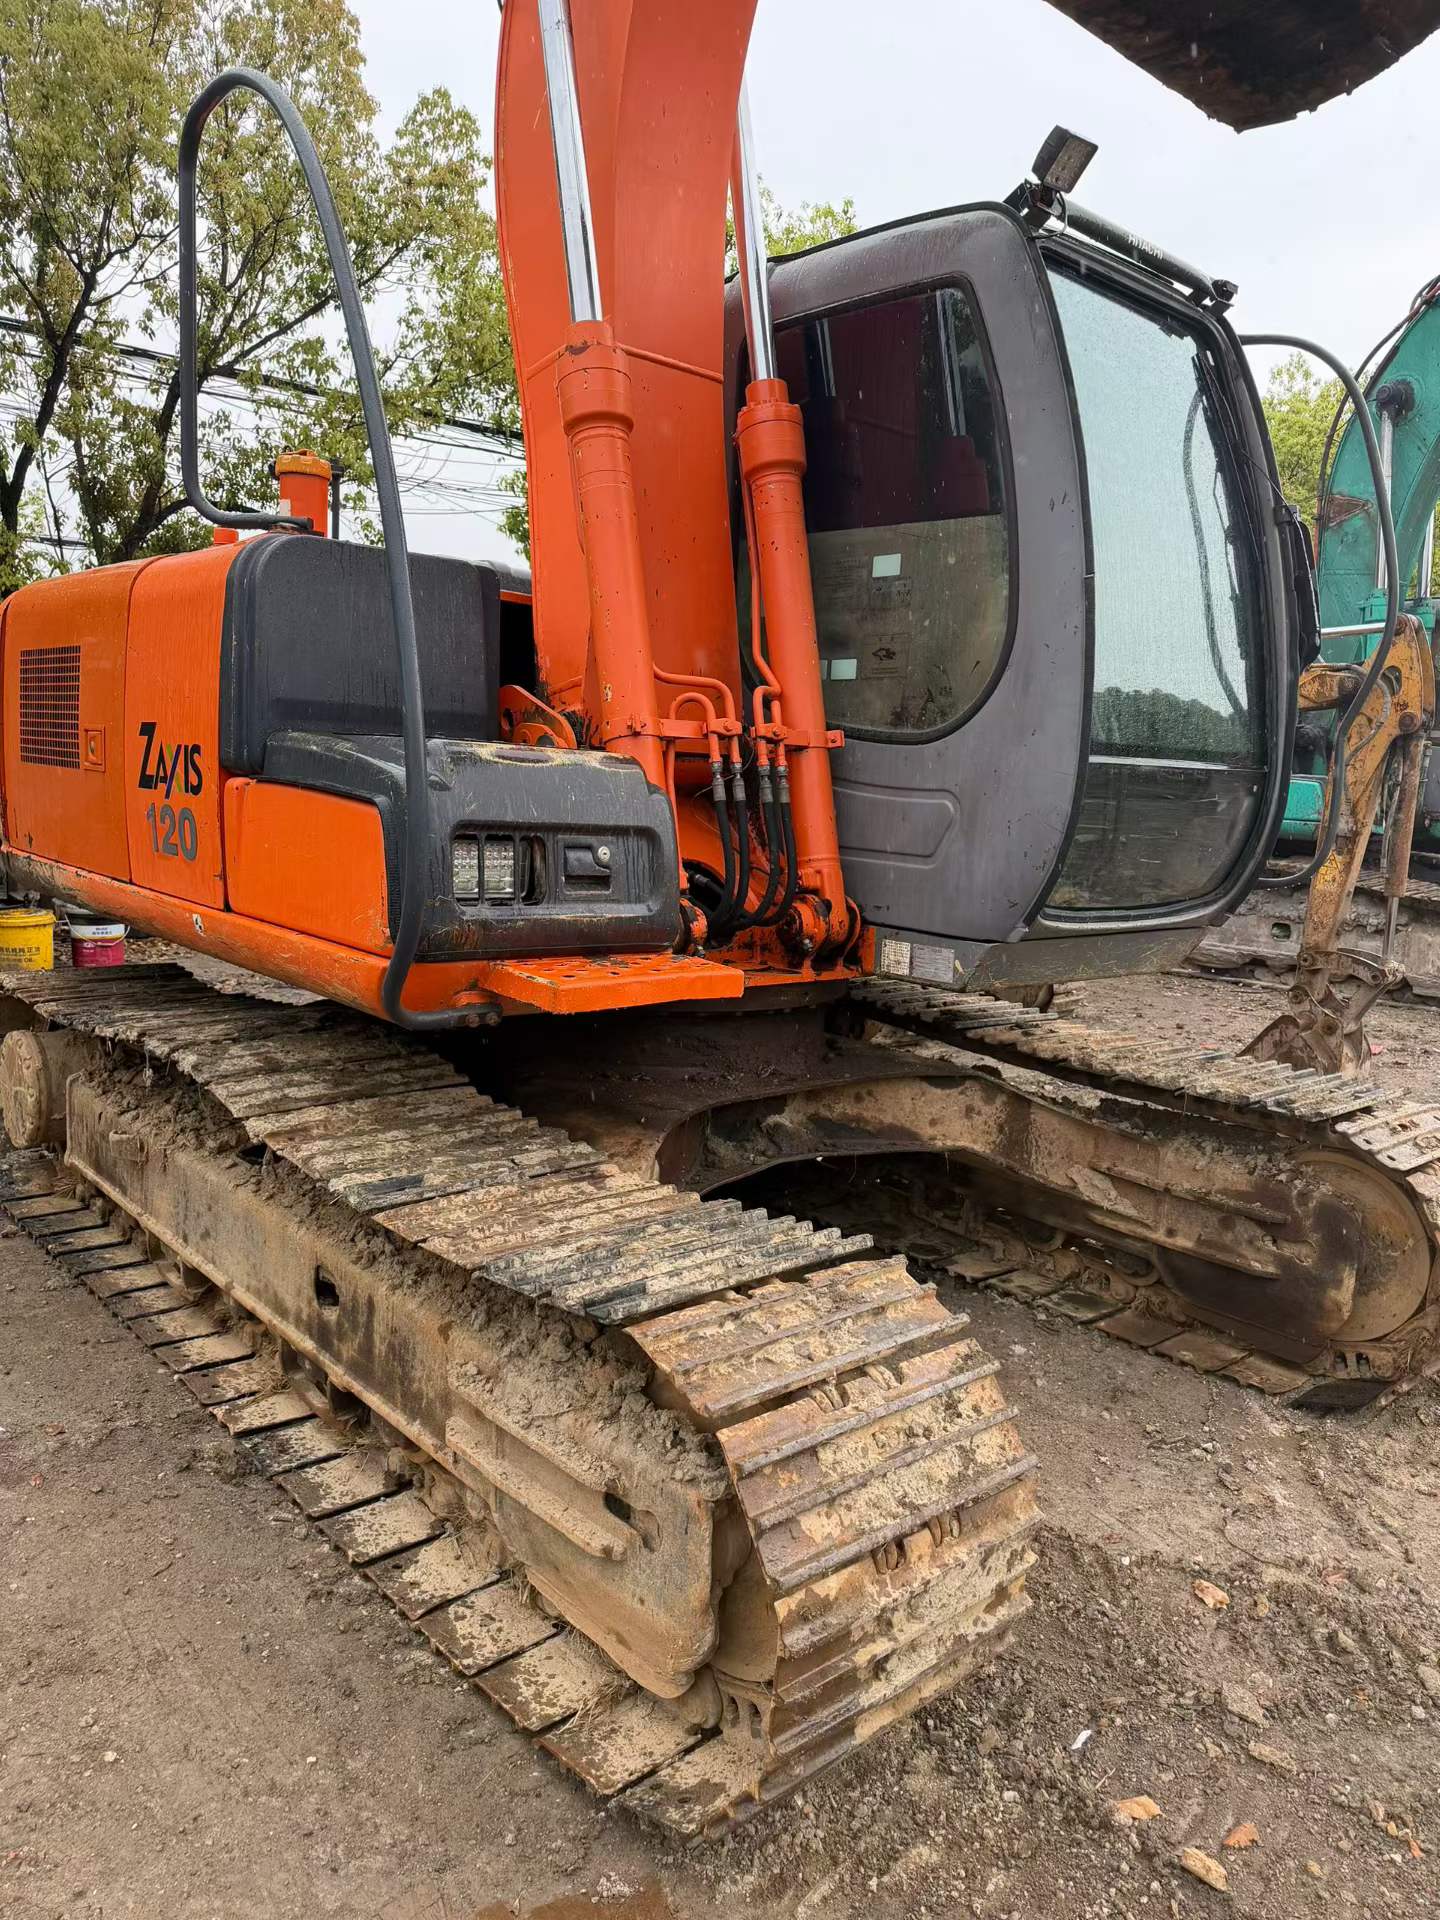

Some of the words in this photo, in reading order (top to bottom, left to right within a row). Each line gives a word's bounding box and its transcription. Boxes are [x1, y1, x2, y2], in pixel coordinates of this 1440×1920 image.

[1128, 234, 1163, 260] HITACHI
[138, 721, 204, 800] ZAXIS
[146, 802, 198, 862] 120
